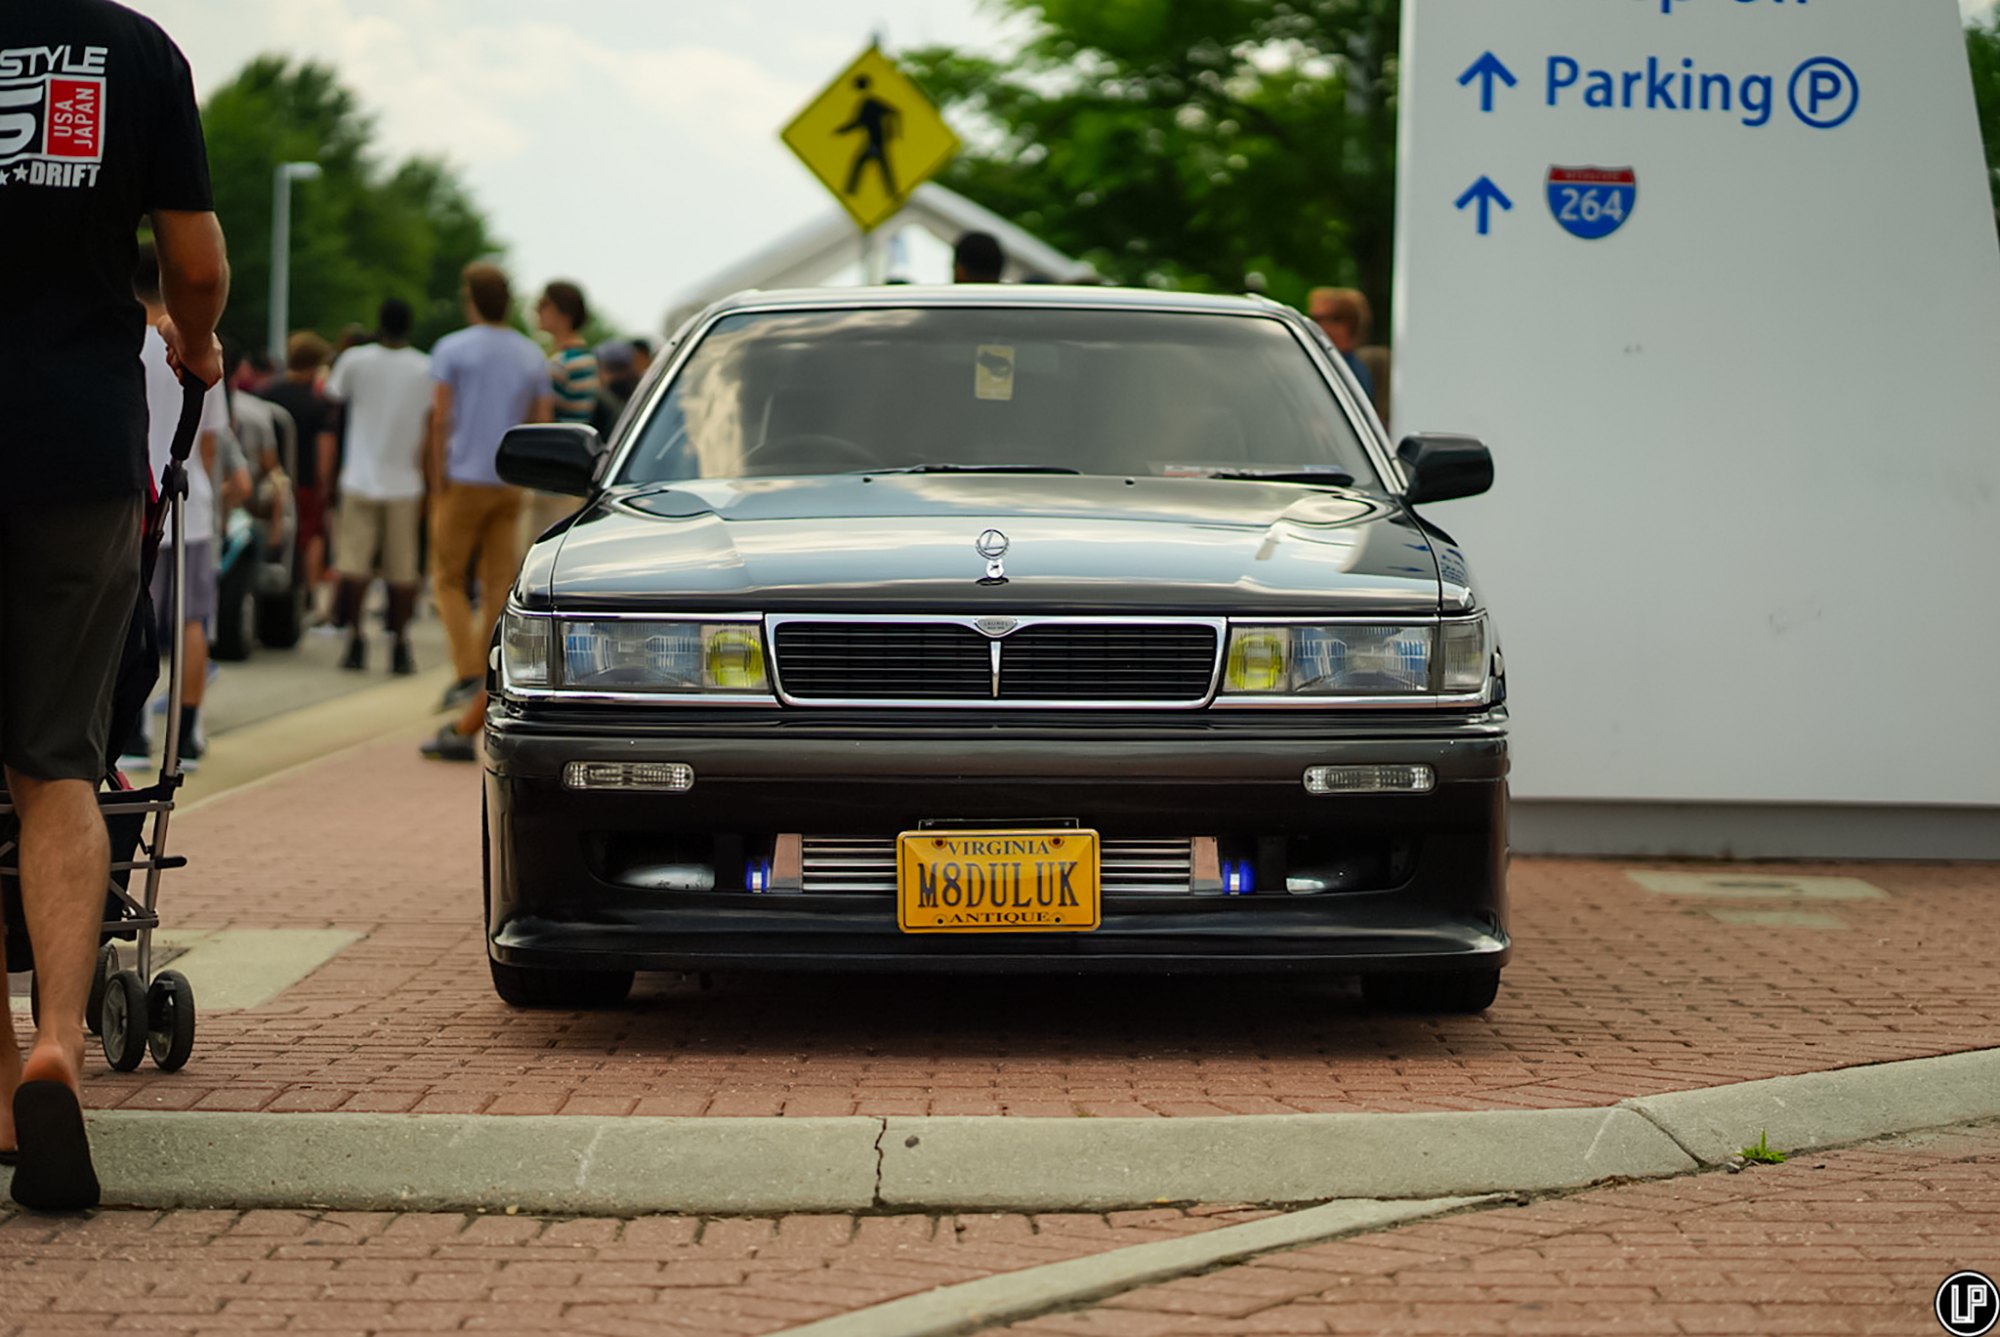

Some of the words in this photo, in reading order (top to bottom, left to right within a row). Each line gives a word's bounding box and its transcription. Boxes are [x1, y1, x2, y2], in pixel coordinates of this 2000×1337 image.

[0, 45, 108, 77] STYLE
[1546, 56, 1773, 127] Parking
[53, 99, 74, 137] USA
[73, 87, 95, 150] JAPAN
[29, 160, 101, 187] DRIFT
[1559, 187, 1625, 222] 264
[947, 840, 1050, 856] VIRGINIA
[917, 861, 1080, 908] M8DULUK
[949, 911, 1050, 924] ANTIQUE
